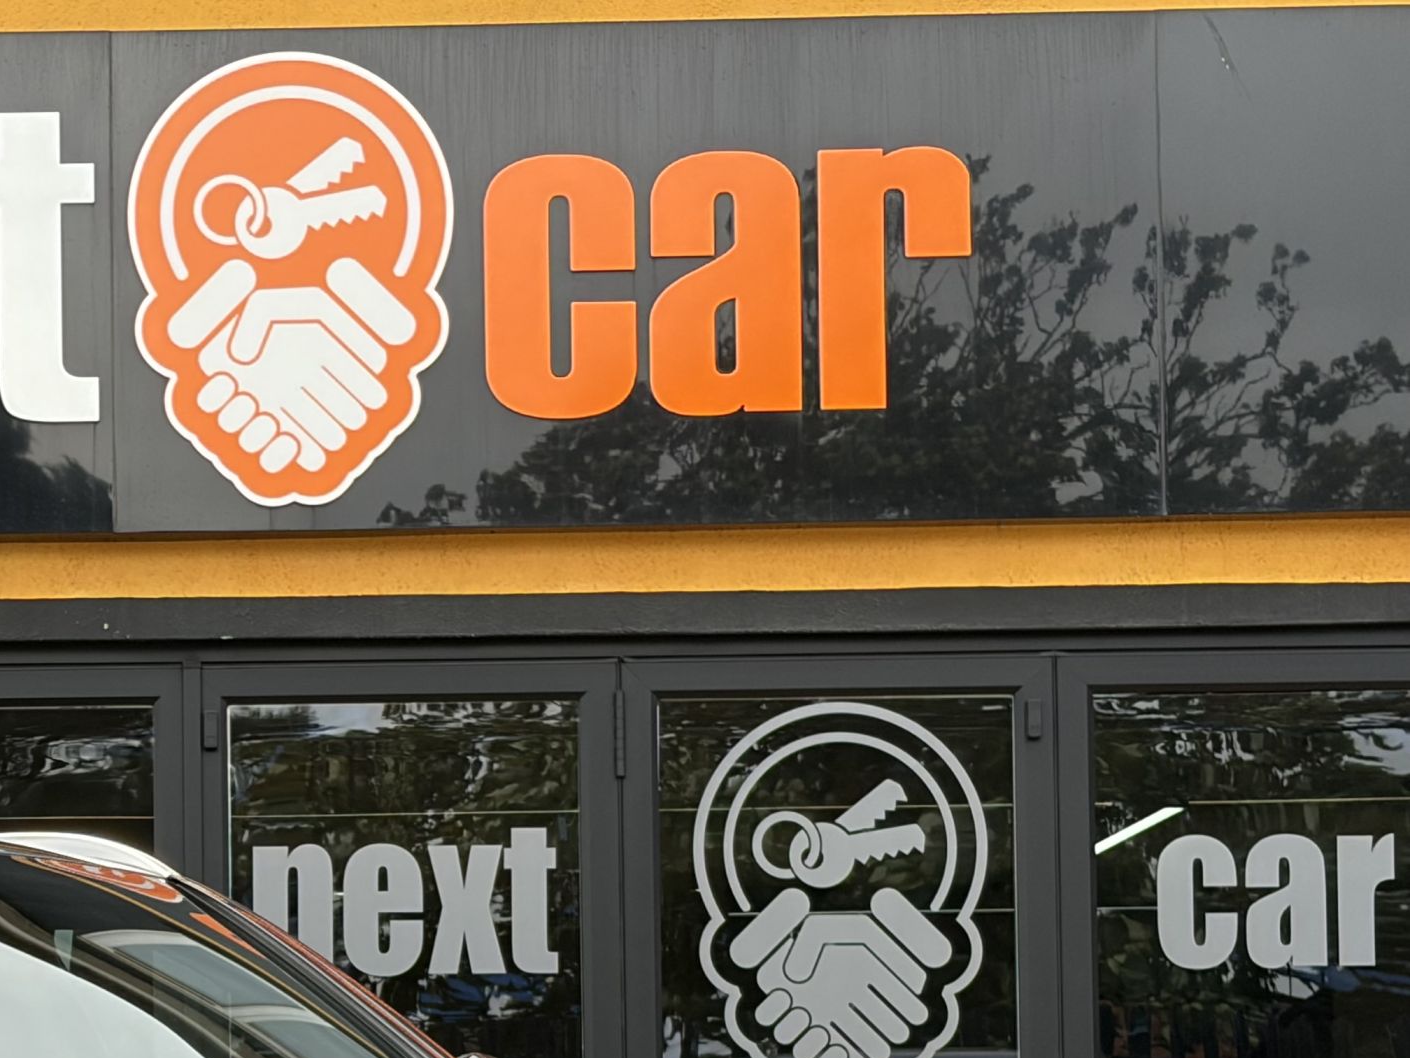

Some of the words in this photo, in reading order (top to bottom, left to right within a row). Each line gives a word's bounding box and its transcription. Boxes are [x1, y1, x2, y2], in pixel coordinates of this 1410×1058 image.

[483, 146, 972, 420] car
[252, 827, 559, 977] next
[1156, 832, 1394, 971] car
